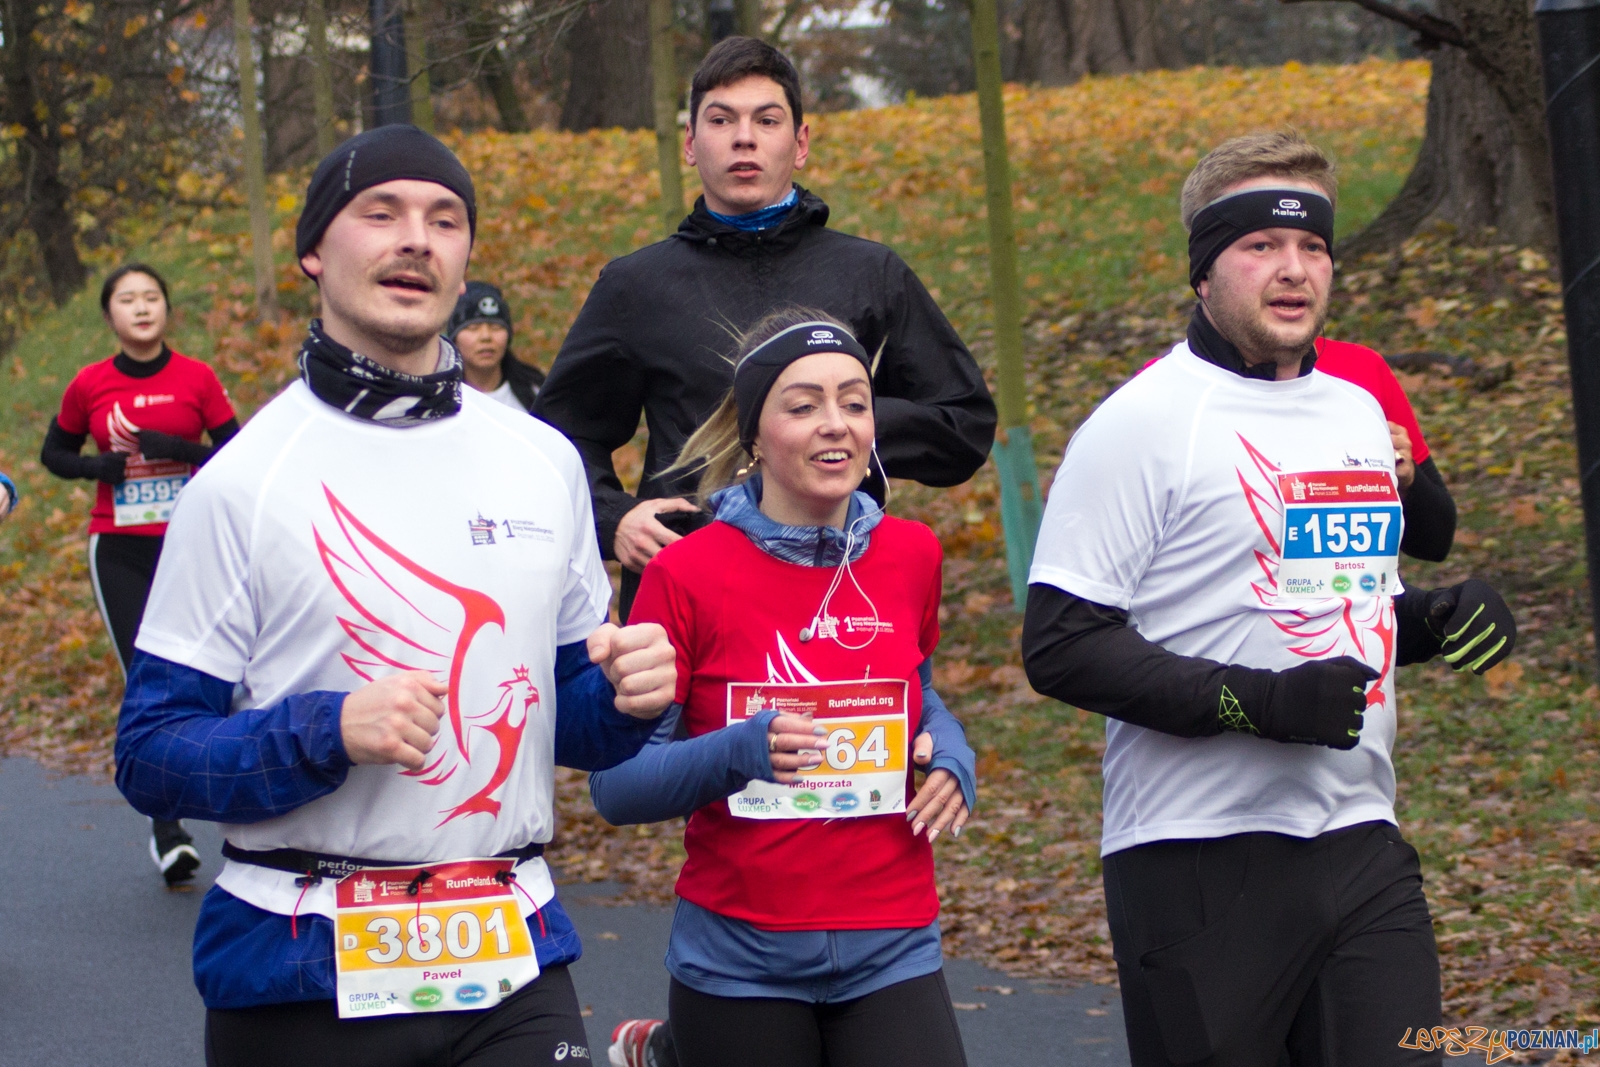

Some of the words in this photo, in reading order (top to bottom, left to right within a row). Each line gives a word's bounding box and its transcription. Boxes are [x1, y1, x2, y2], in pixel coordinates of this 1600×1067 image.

[1272, 208, 1307, 218] Kalenji
[123, 479, 183, 503] 9595
[1307, 482, 1315, 496] 1
[1346, 484, 1391, 494] RunPoland.org
[502, 519, 515, 538] 1
[1288, 527, 1298, 541] E
[1305, 513, 1391, 553] 1557
[1334, 562, 1365, 570] Bartosz
[844, 616, 855, 632] 1
[769, 697, 777, 711] 1
[828, 696, 894, 708] RunPoland.org
[379, 881, 389, 896] 1
[343, 934, 358, 950] D
[366, 907, 510, 964] 3801
[423, 969, 462, 980] Paweł
[348, 992, 380, 1002] GRUPA
[350, 1001, 386, 1011] LUXMED
